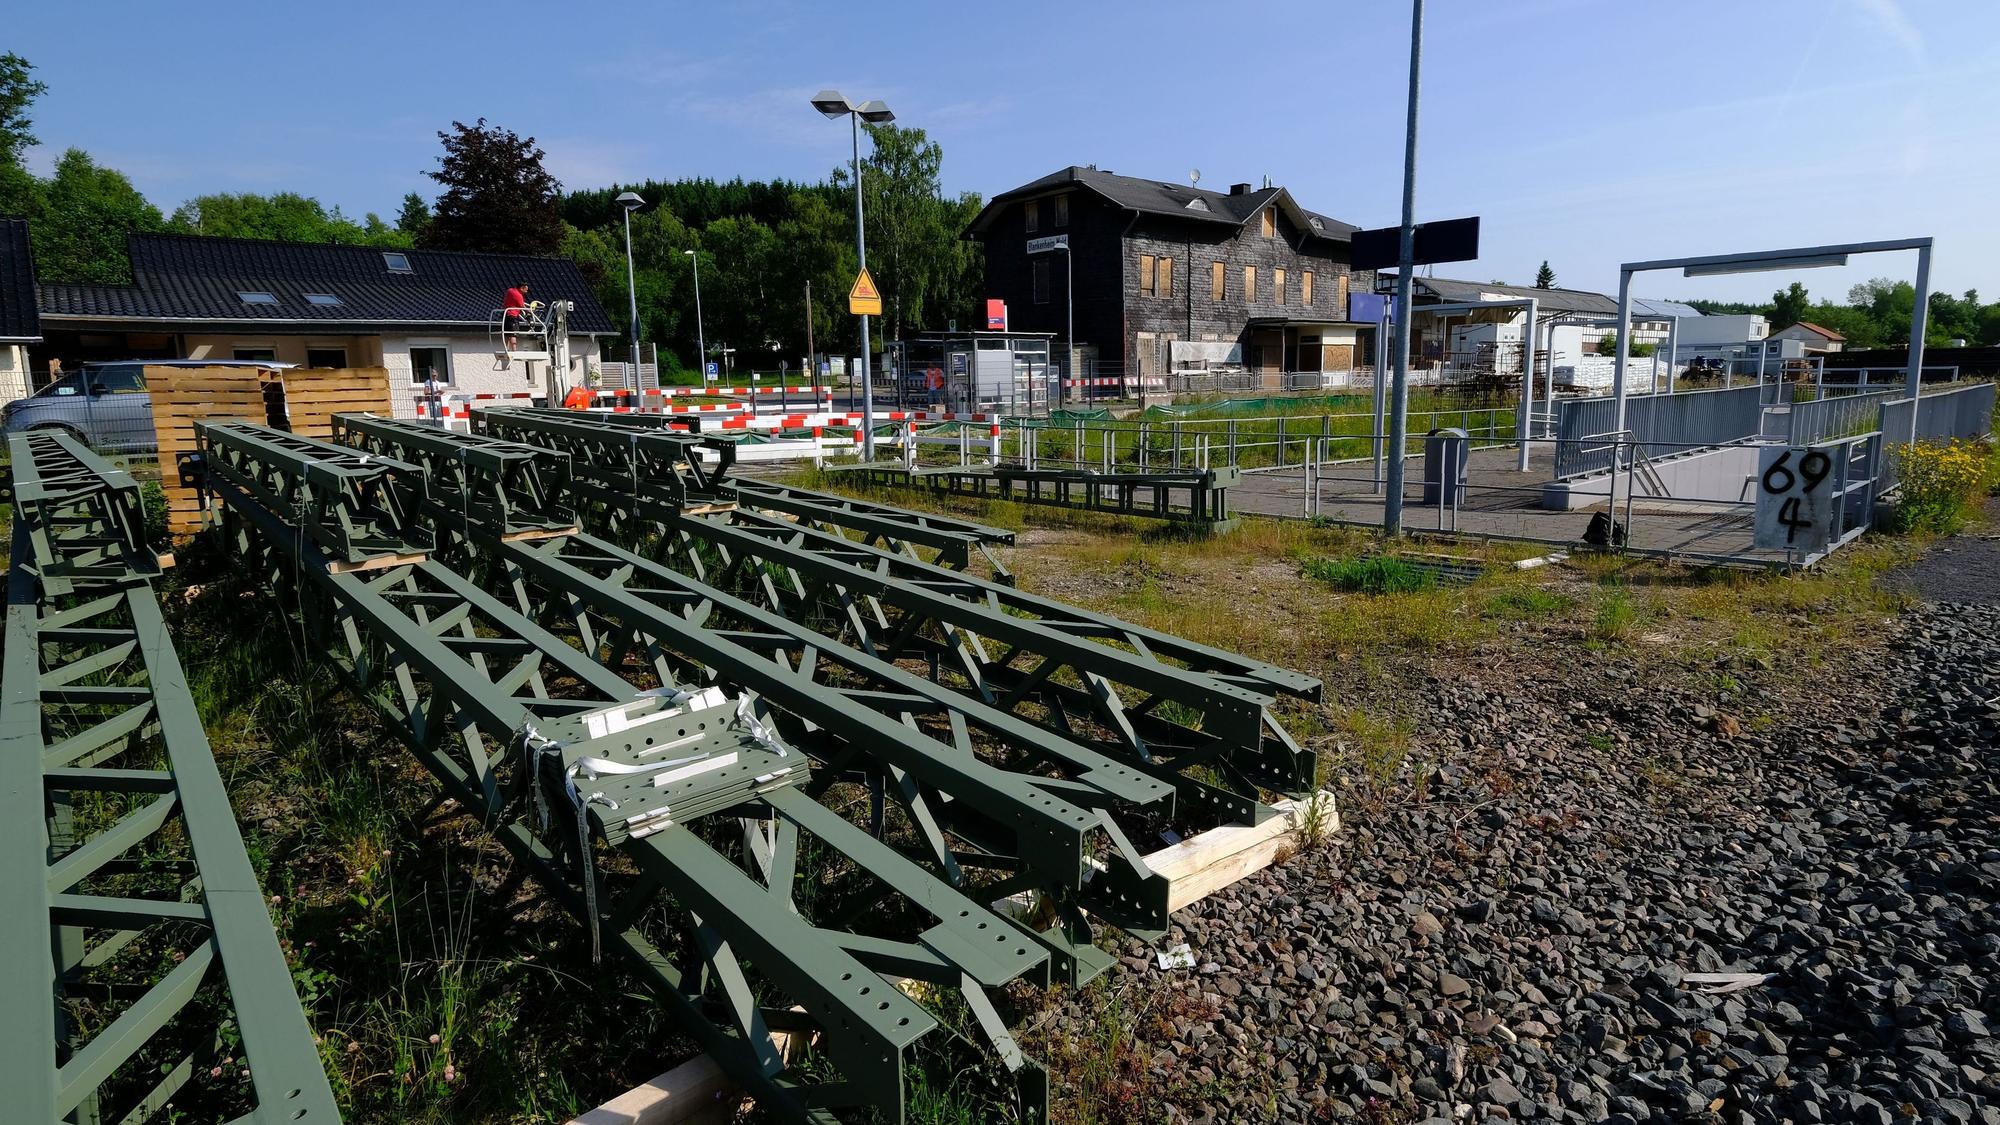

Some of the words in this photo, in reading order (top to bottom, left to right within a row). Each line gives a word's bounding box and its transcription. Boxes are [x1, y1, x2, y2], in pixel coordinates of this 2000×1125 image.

[1028, 239, 1055, 252] Blankenheim
[1762, 450, 1831, 494] 69
[1778, 496, 1812, 544] 4
